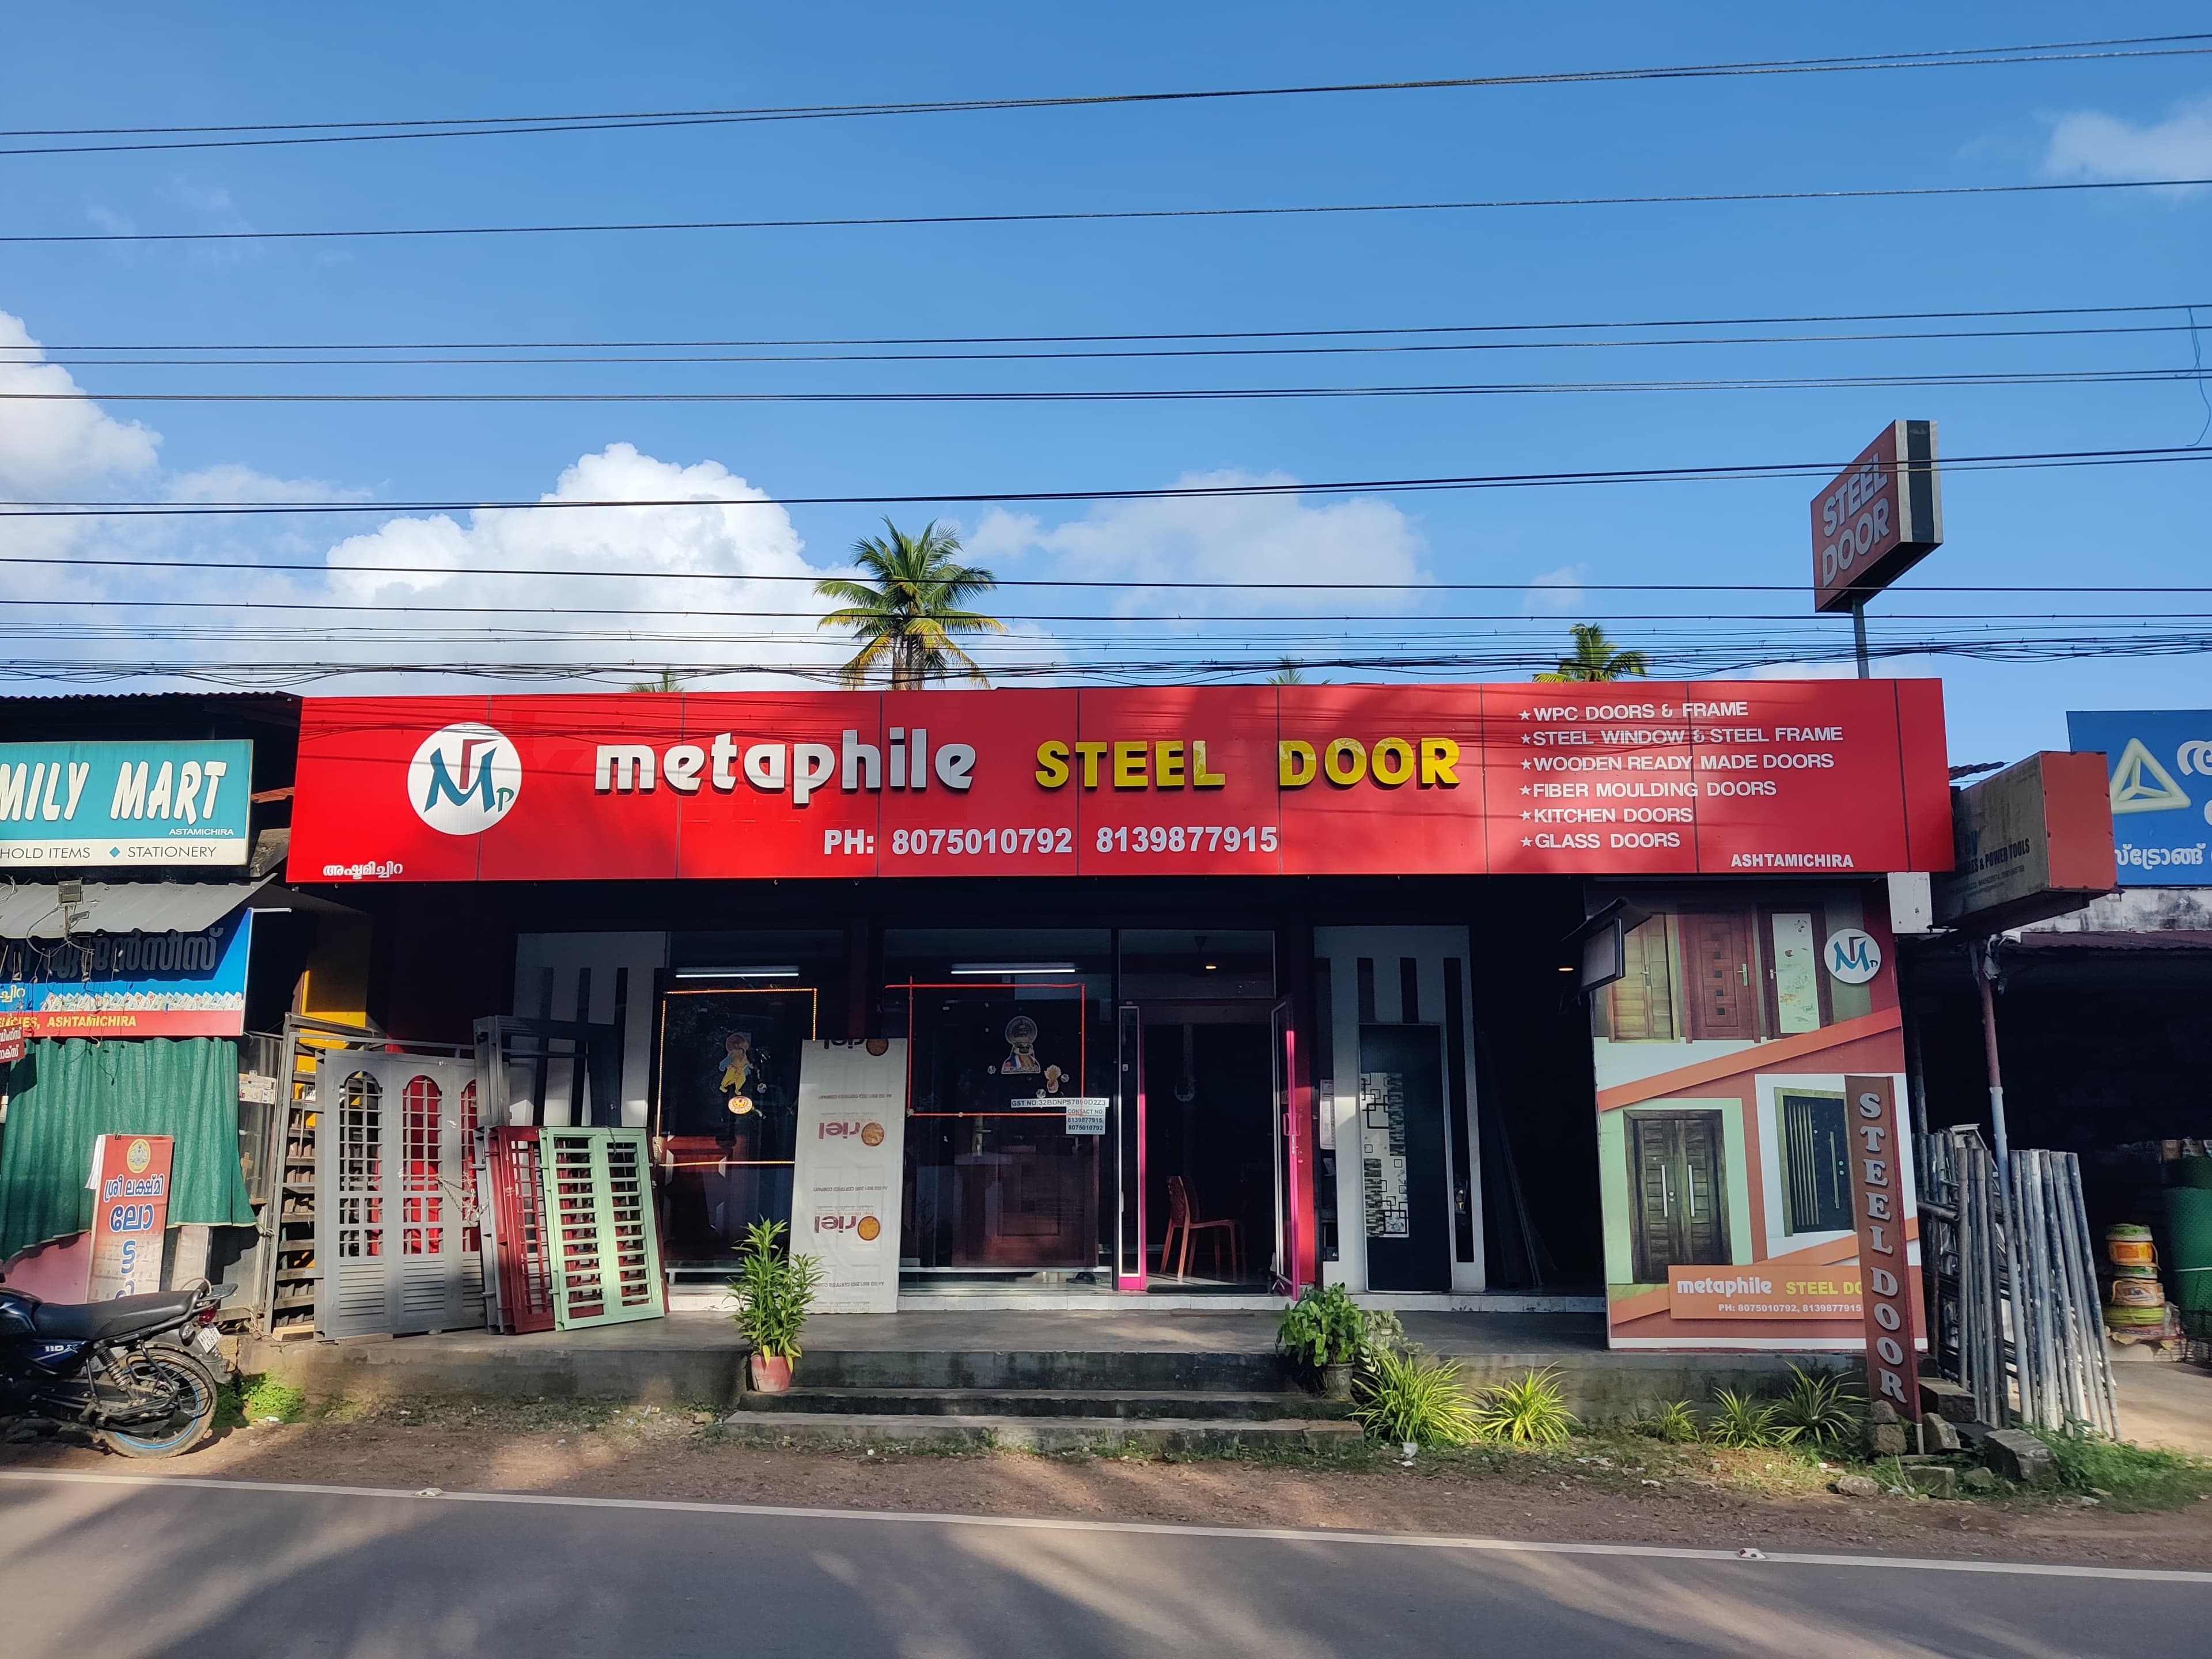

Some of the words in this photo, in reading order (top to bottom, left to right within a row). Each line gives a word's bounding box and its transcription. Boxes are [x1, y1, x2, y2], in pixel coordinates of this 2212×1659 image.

[1823, 452, 1888, 537] STEEL
[1822, 498, 1890, 587] DOOR
[1533, 707, 1578, 722] WPC
[1585, 704, 1655, 721] DOORS
[1661, 703, 1673, 718] &
[1682, 702, 1748, 718] FRAME
[1533, 730, 1593, 746] STEEL
[1601, 729, 1684, 745] WINDOW
[1693, 728, 1705, 742] &
[1710, 728, 1769, 743] STEEL
[1775, 726, 1843, 742] FRAME
[594, 727, 976, 806] metaphile
[1035, 740, 1226, 788] STEEL
[1279, 737, 1460, 789] DOOR
[1534, 756, 1622, 771] WOODEN
[1627, 755, 1692, 771] READY
[1701, 755, 1758, 770] MADE
[1763, 753, 1834, 768] DOORS
[0, 762, 90, 821] MILY
[110, 761, 228, 825] MART
[1533, 783, 1589, 798] FIBER
[1596, 782, 1698, 797] MOULDING
[1707, 781, 1777, 797] DOORS
[1534, 808, 1616, 823] KITCHEN
[1624, 807, 1693, 823] DOORS
[824, 830, 873, 854] PH:
[892, 828, 1073, 855] 8075010792
[1096, 826, 1278, 853] 8139877915
[1535, 833, 1600, 849] GLASS
[1610, 832, 1680, 848] DOORS
[0, 847, 43, 859] HOLD
[49, 847, 90, 858] ITEMS
[128, 846, 217, 857] STATIONERY
[1731, 854, 1854, 868] ASHTAMICHIRA
[1985, 847, 2008, 869] POWER
[2009, 838, 2030, 859] TOOLS
[47, 1016, 137, 1027] ASHTAMICHIRA
[1859, 1092, 1893, 1255] STEEL
[814, 1215, 880, 1241] Oriel
[1677, 1277, 1772, 1298] metaphile
[1786, 1281, 1838, 1295] STEEL
[1738, 1304, 1800, 1313] 8075010792,
[1872, 1266, 1908, 1404] DOOR
